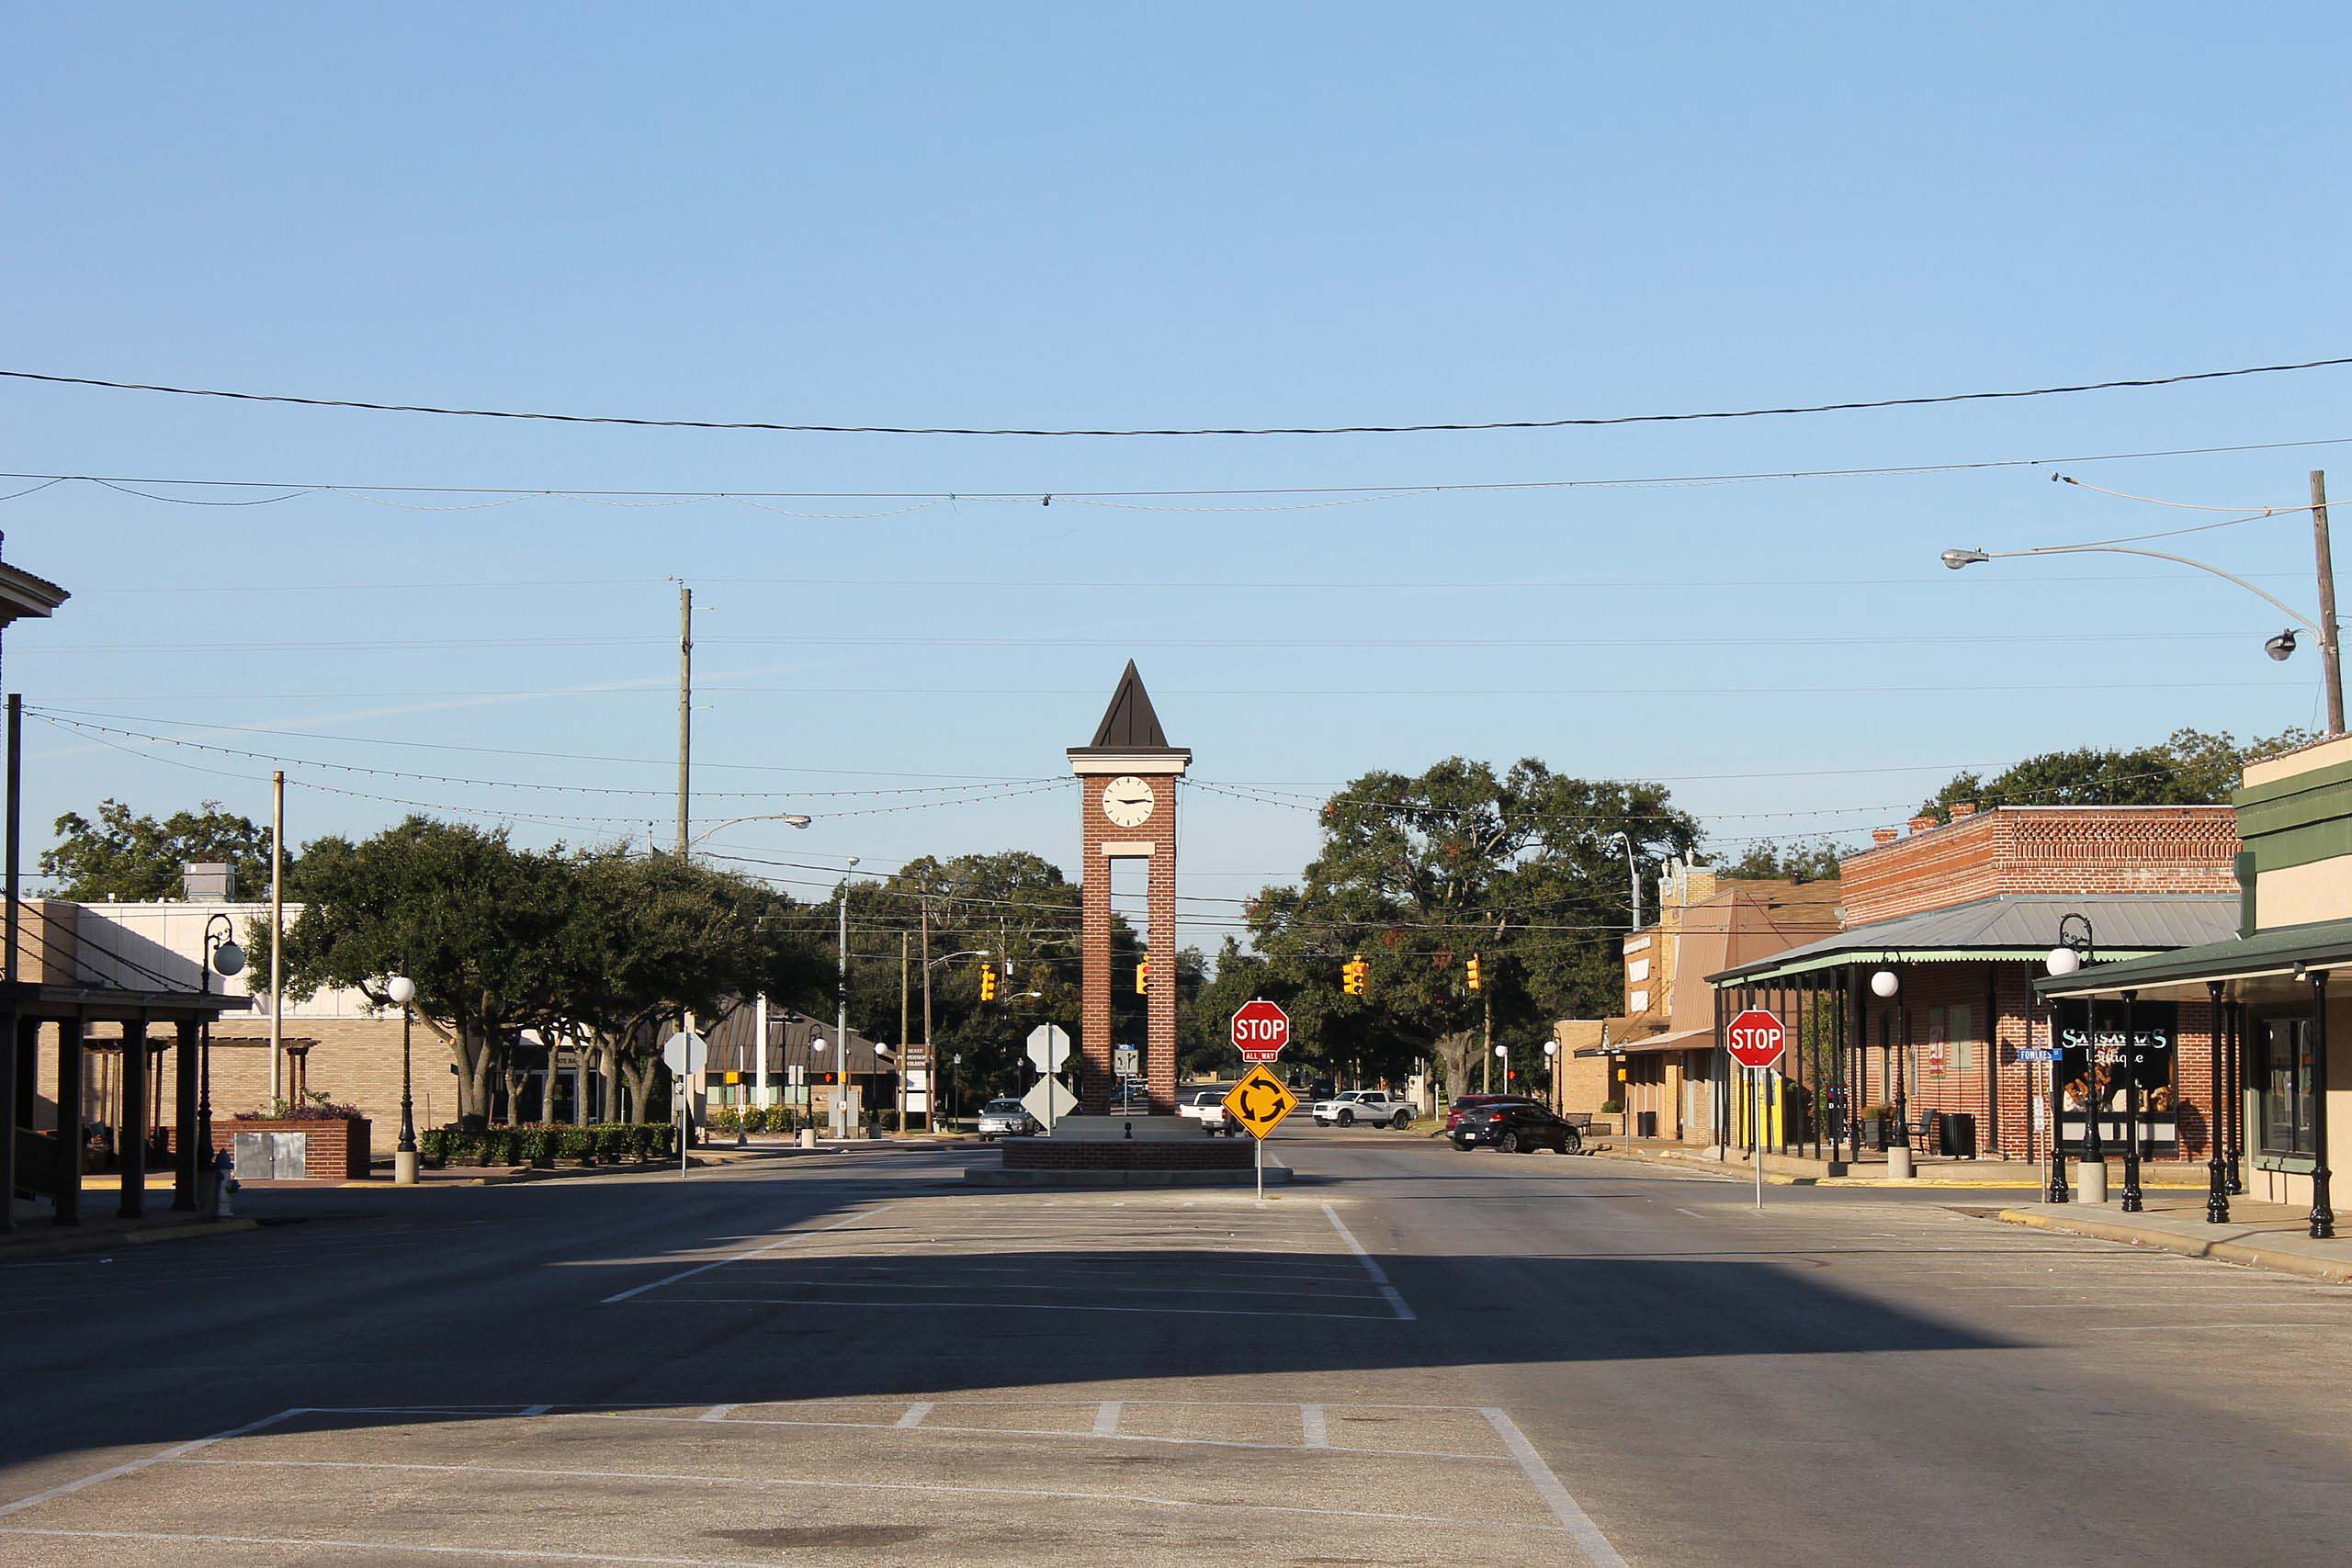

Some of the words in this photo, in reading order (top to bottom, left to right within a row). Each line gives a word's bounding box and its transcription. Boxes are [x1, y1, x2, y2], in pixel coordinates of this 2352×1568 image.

[1236, 1019, 1285, 1041] STOP
[1731, 1028, 1781, 1050] STOP
[1246, 1052, 1259, 1060] ALL
[1261, 1052, 1275, 1060] WAY
[2020, 1049, 2052, 1060] FOWLKES
